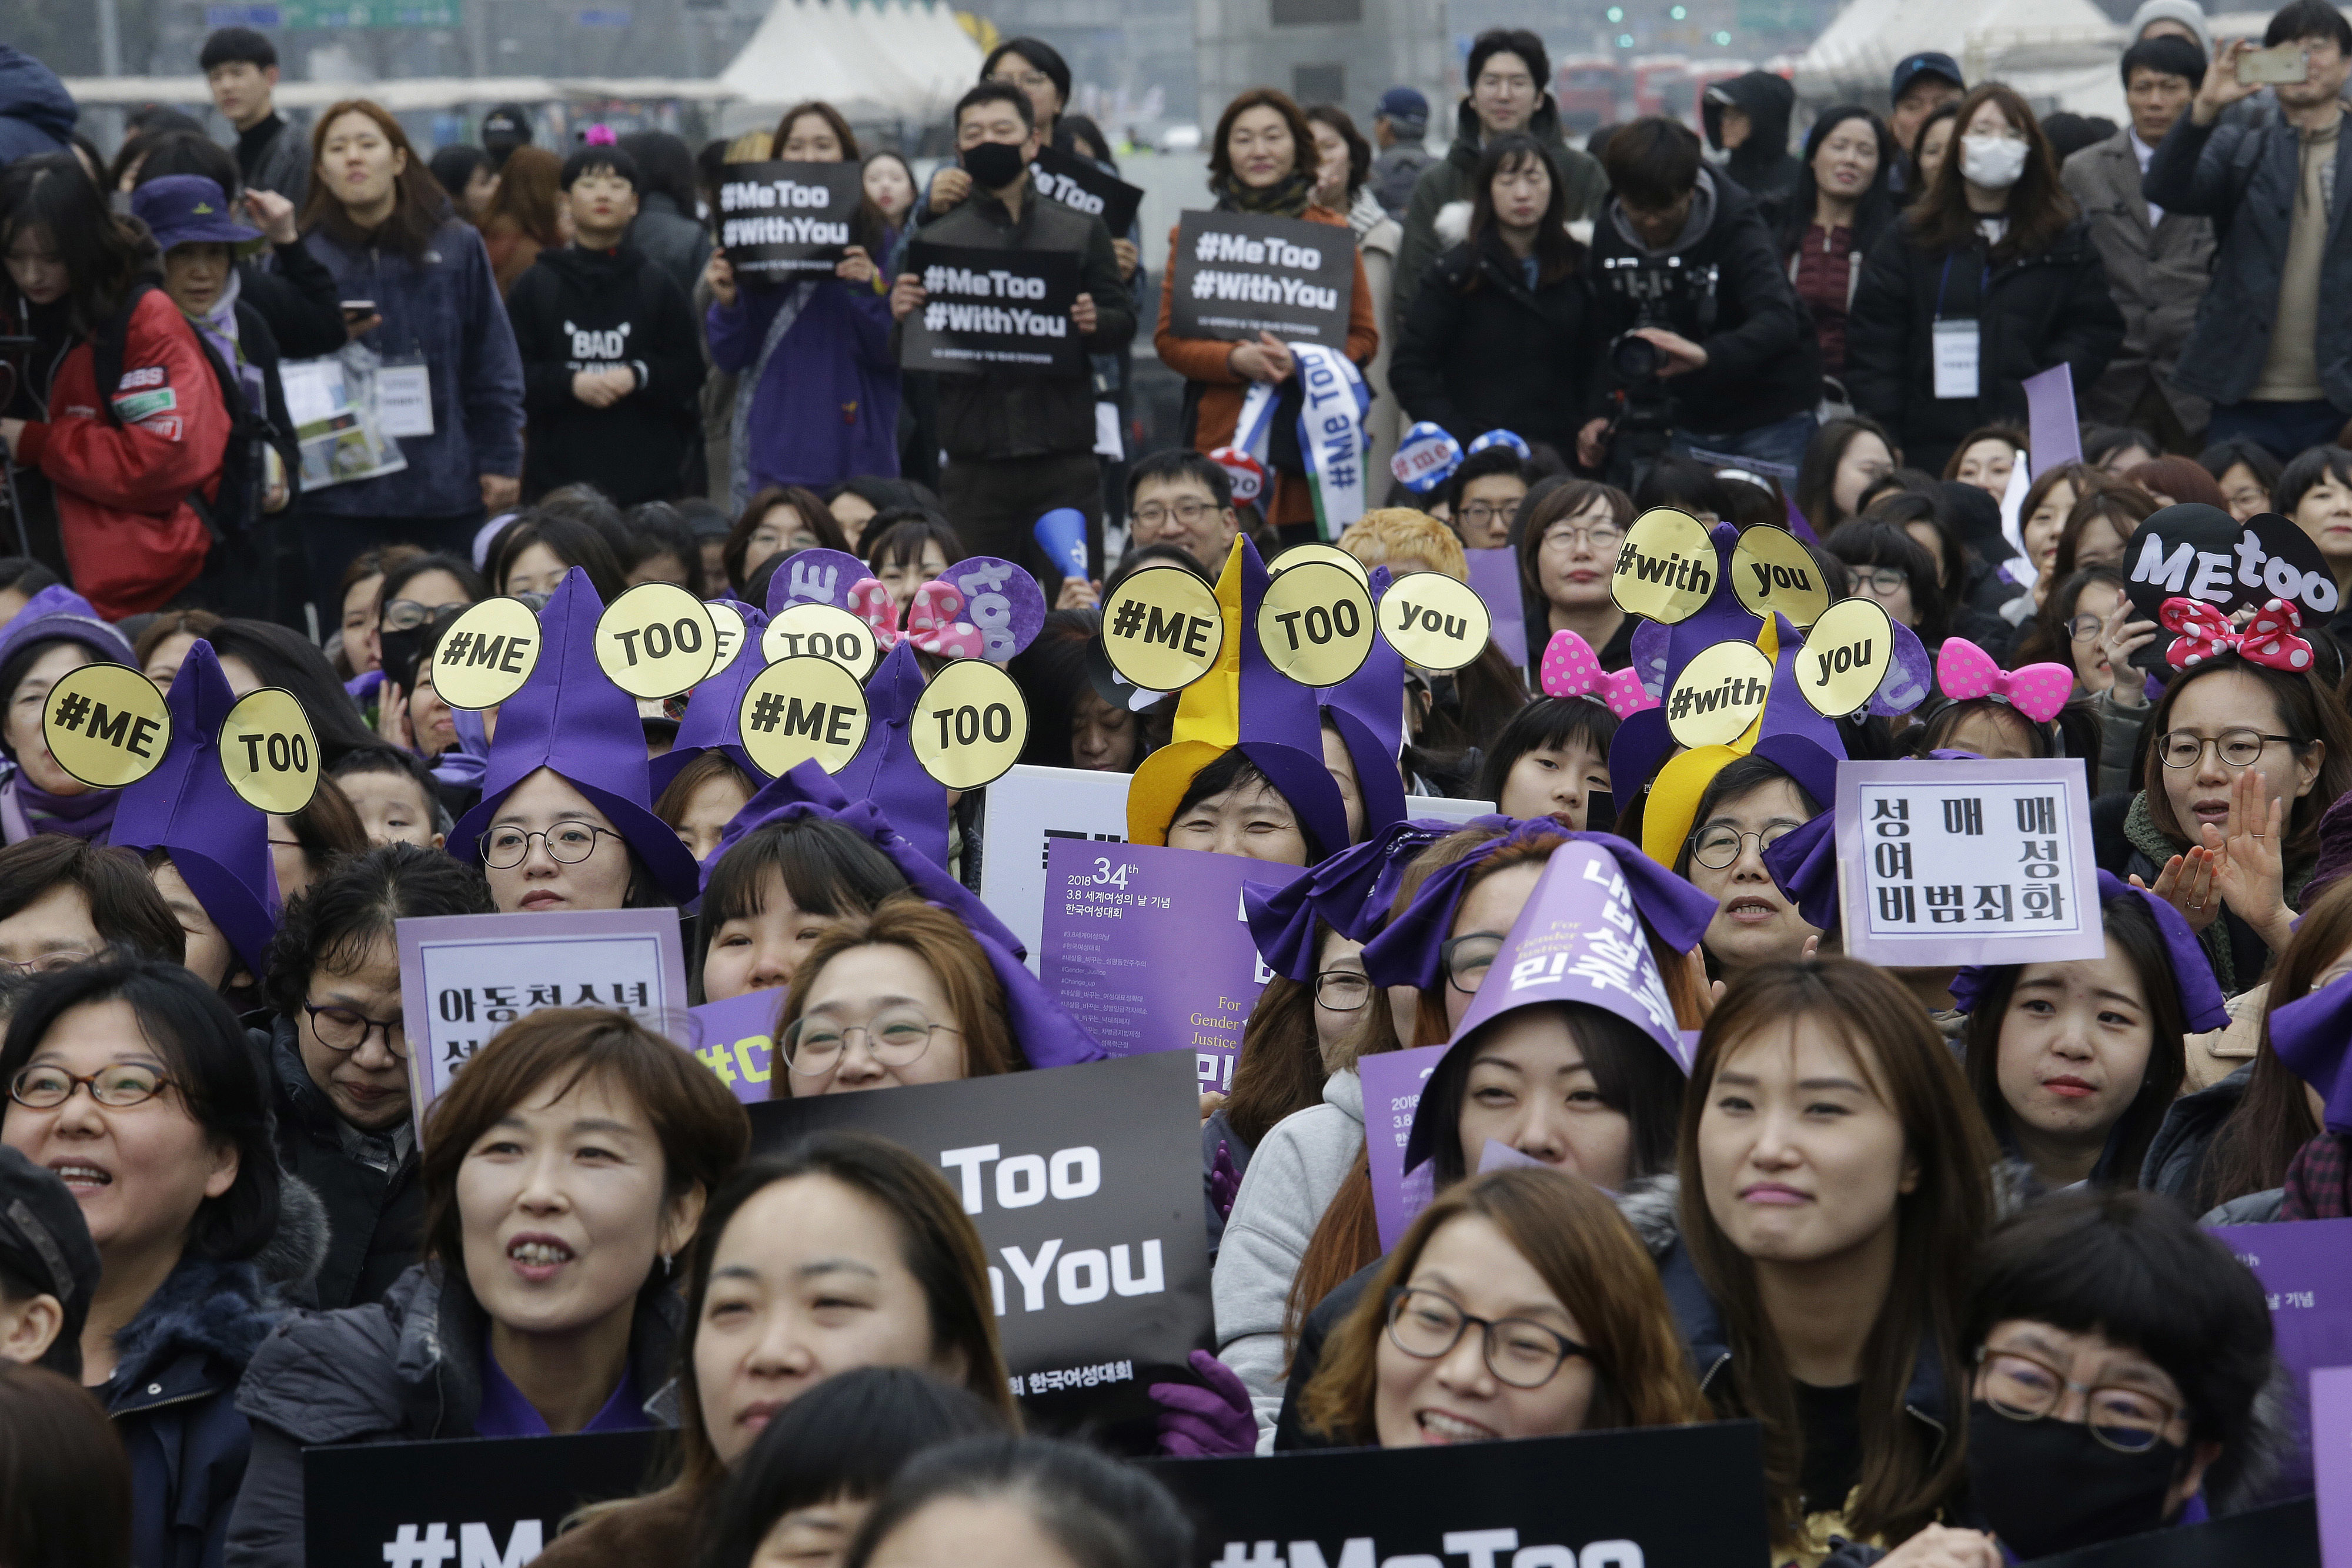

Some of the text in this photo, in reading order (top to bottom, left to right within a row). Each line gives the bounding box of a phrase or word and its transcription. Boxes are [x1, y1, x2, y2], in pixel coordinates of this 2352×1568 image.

[721, 180, 829, 212] #MeToo
[723, 216, 849, 248] #WithYou
[1196, 232, 1321, 270] #MeToo
[924, 265, 1046, 300] #MeToo
[1191, 269, 1338, 311] #WithYou
[924, 301, 1066, 337] #WithYou
[572, 330, 623, 359] BAD
[1303, 354, 1339, 409] Too
[1324, 414, 1355, 489] #Me
[1614, 542, 1711, 595] #with
[1750, 560, 1813, 597] you
[2130, 530, 2338, 612] ME too
[1112, 599, 1214, 657] #ME
[1275, 599, 1360, 651] TOO
[1398, 600, 1468, 641] you
[441, 632, 531, 673] #ME
[614, 618, 702, 666] TOO
[781, 632, 862, 661] TOO
[1816, 638, 1872, 686] you
[1670, 676, 1766, 720] #with
[54, 692, 161, 758] #ME
[750, 692, 857, 745] #ME
[933, 703, 1012, 750] TOO
[238, 732, 308, 773] TOO
[1066, 889, 1171, 909] 3.8 세계여성의 날 기념
[1067, 875, 1091, 886] 2018
[1065, 904, 1122, 919] 한국여성대회
[1876, 883, 2065, 924] 비범죄화
[1061, 967, 1107, 976] #Gender_Justice
[1061, 978, 1095, 987] #Change_up
[1190, 1012, 1239, 1030] Gender
[1218, 996, 1241, 1011] For
[1191, 1032, 1237, 1049] Justice
[1028, 1359, 1134, 1395] 한국여성대회
